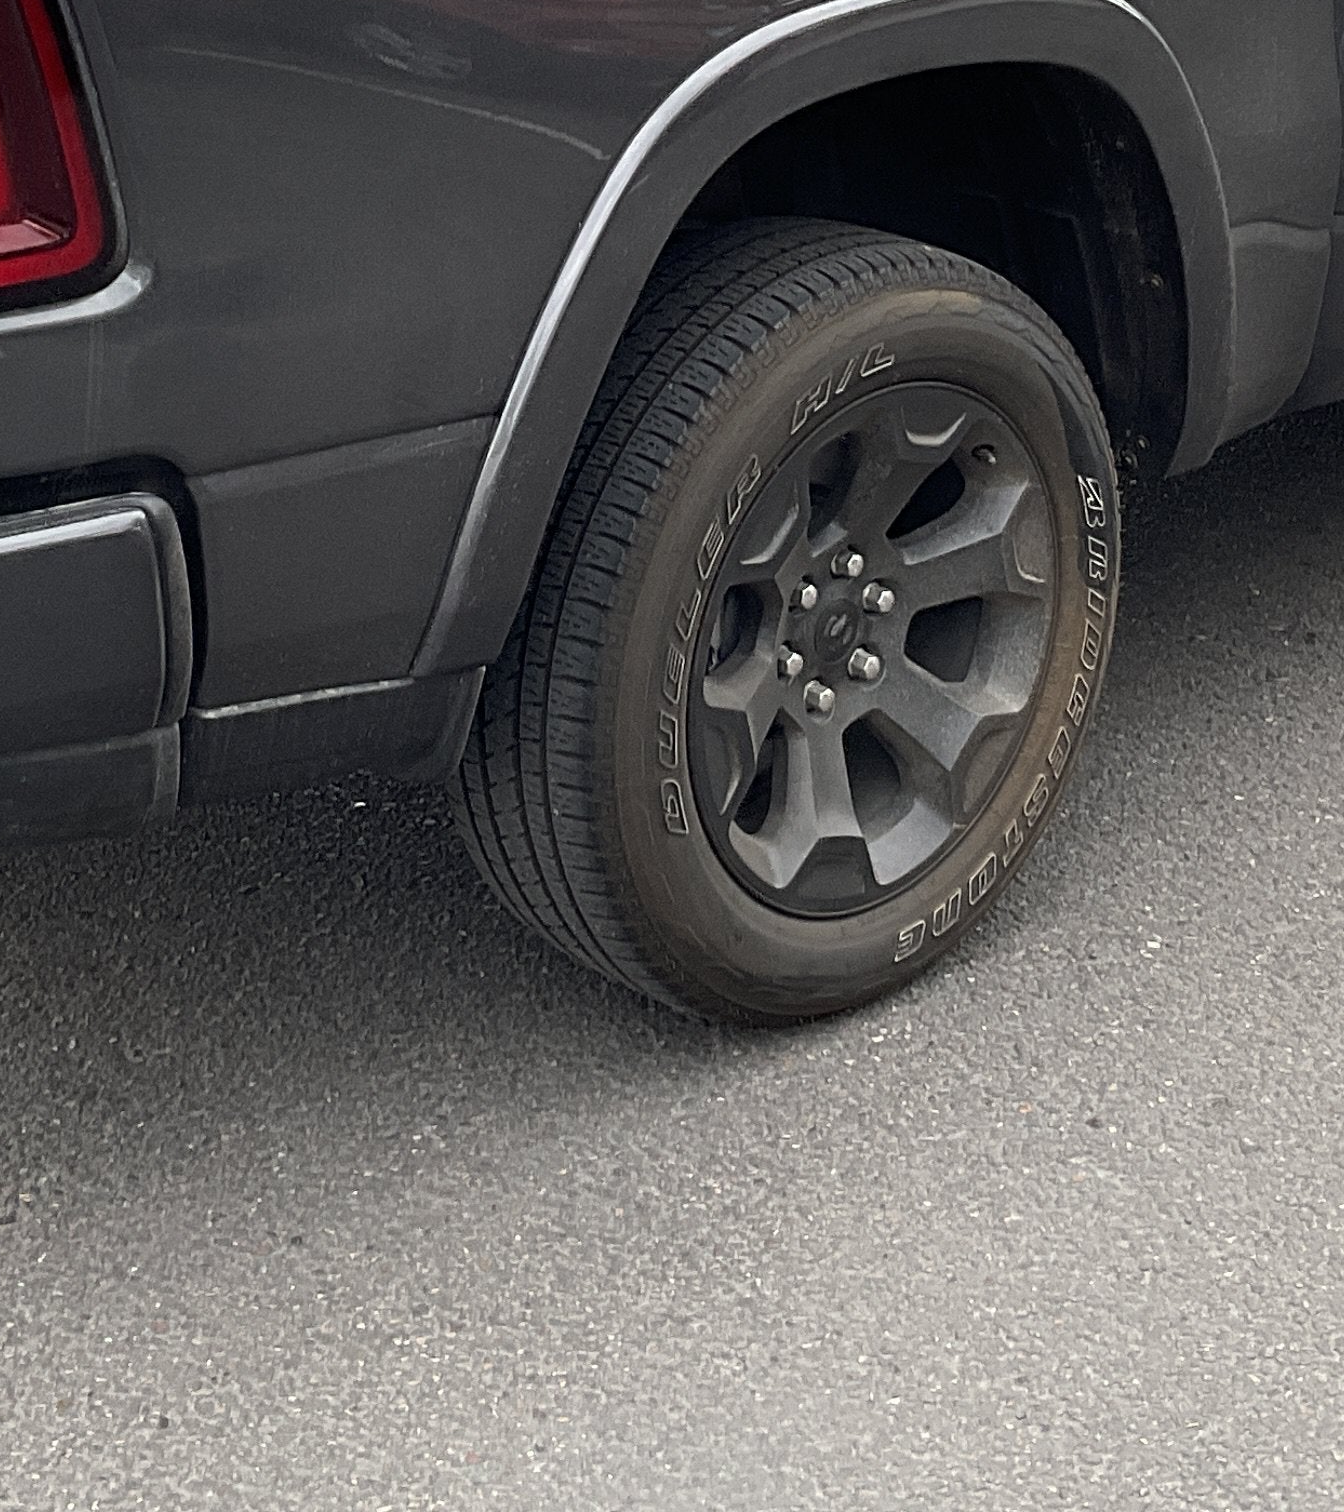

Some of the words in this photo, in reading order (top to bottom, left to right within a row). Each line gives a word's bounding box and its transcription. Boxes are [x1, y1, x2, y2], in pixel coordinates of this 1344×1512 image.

[659, 454, 762, 835] DUELER
[790, 342, 894, 435] H/L
[894, 474, 1109, 963] BRIDGESTONE
